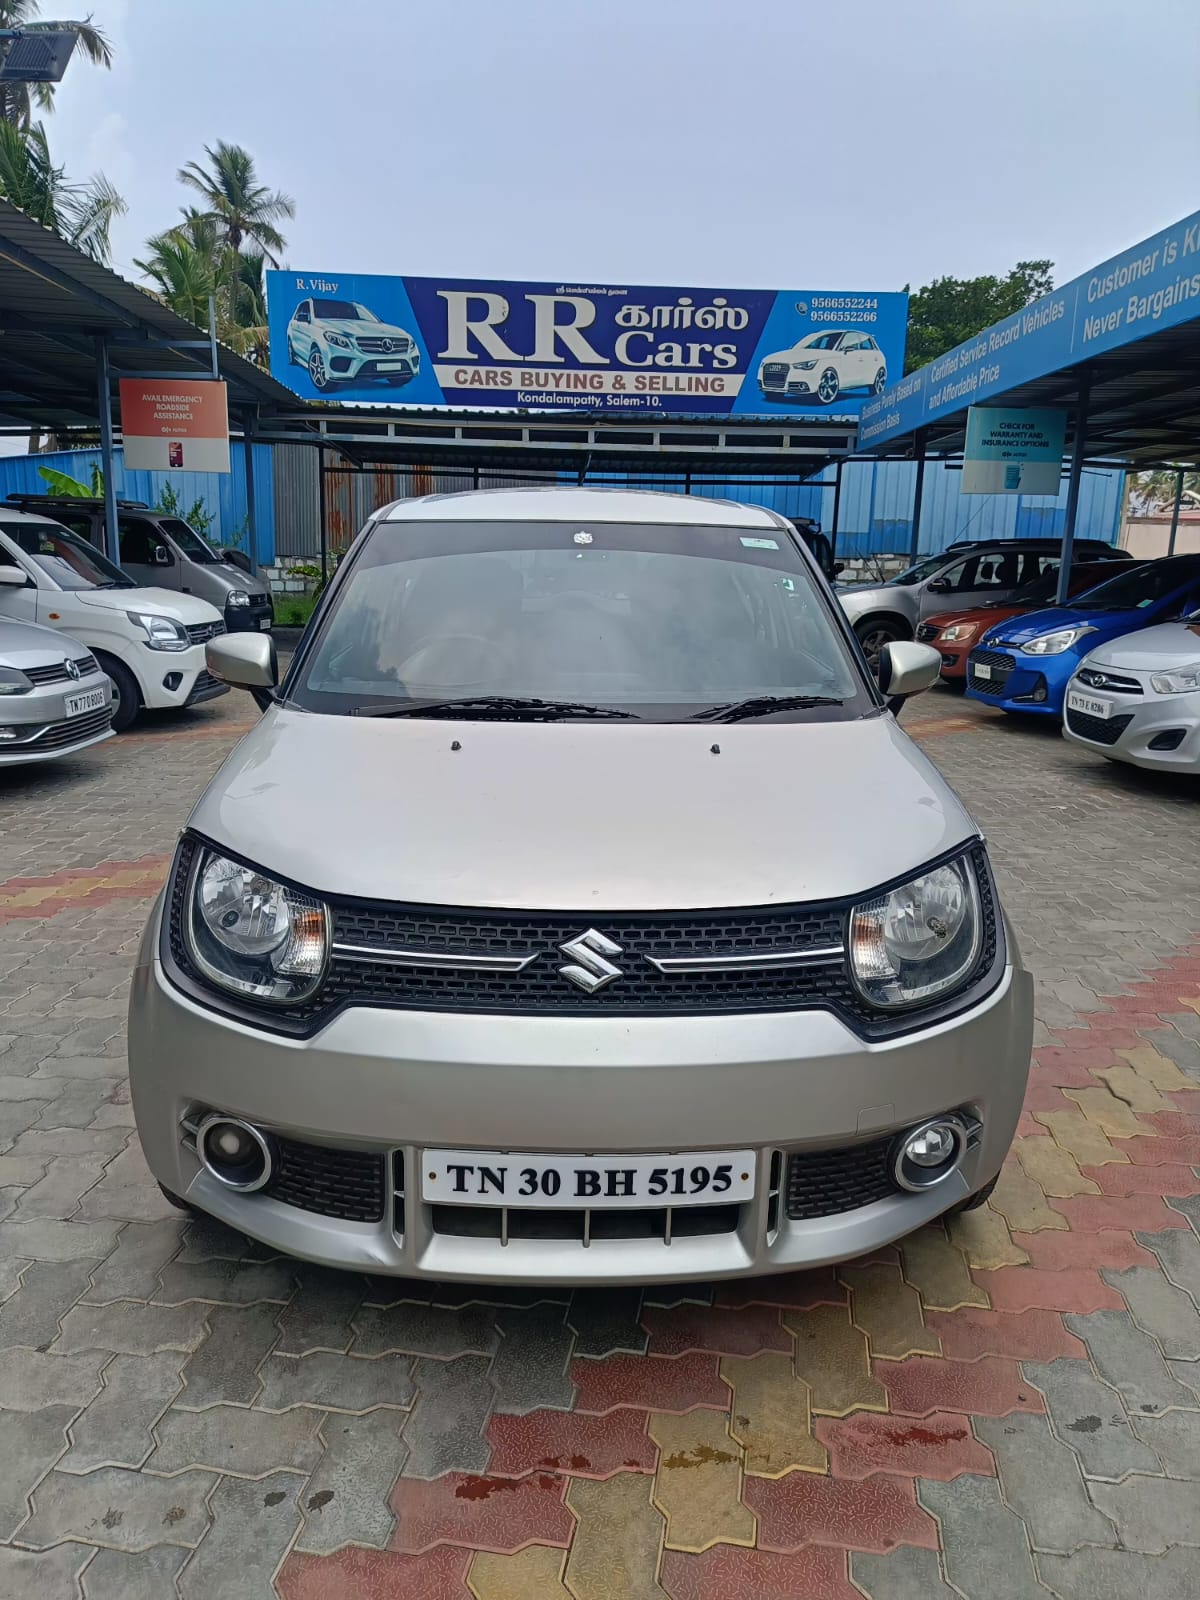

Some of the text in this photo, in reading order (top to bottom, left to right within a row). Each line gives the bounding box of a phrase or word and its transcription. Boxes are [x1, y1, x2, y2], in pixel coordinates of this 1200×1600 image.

[1087, 249, 1160, 303] Customer
[1162, 238, 1178, 267] is
[296, 278, 339, 294] R.Vijay
[811, 297, 878, 309] 9566552244
[1082, 273, 1200, 343] Never Bargains
[614, 297, 749, 330] கார்ஸ்
[810, 311, 878, 322] 9566552266
[614, 331, 738, 369] Cars
[931, 301, 1065, 383] Certified Service Record Vehicles
[454, 368, 725, 393] CARS BUYING & SELLING
[941, 371, 978, 404] Affordable
[978, 364, 1000, 388] Price
[162, 394, 203, 404] EMERGENCY
[517, 391, 663, 408] Kondalampatty, Salem-10.
[153, 411, 193, 420] ASSISTANCE
[156, 403, 190, 412] ROADSIDE
[999, 422, 1021, 430] CHECK
[990, 431, 1028, 439] WARRANTY
[981, 439, 1049, 448] INSURANCE OPTIONS
[447, 1165, 733, 1196] TN 30 BH 5195
